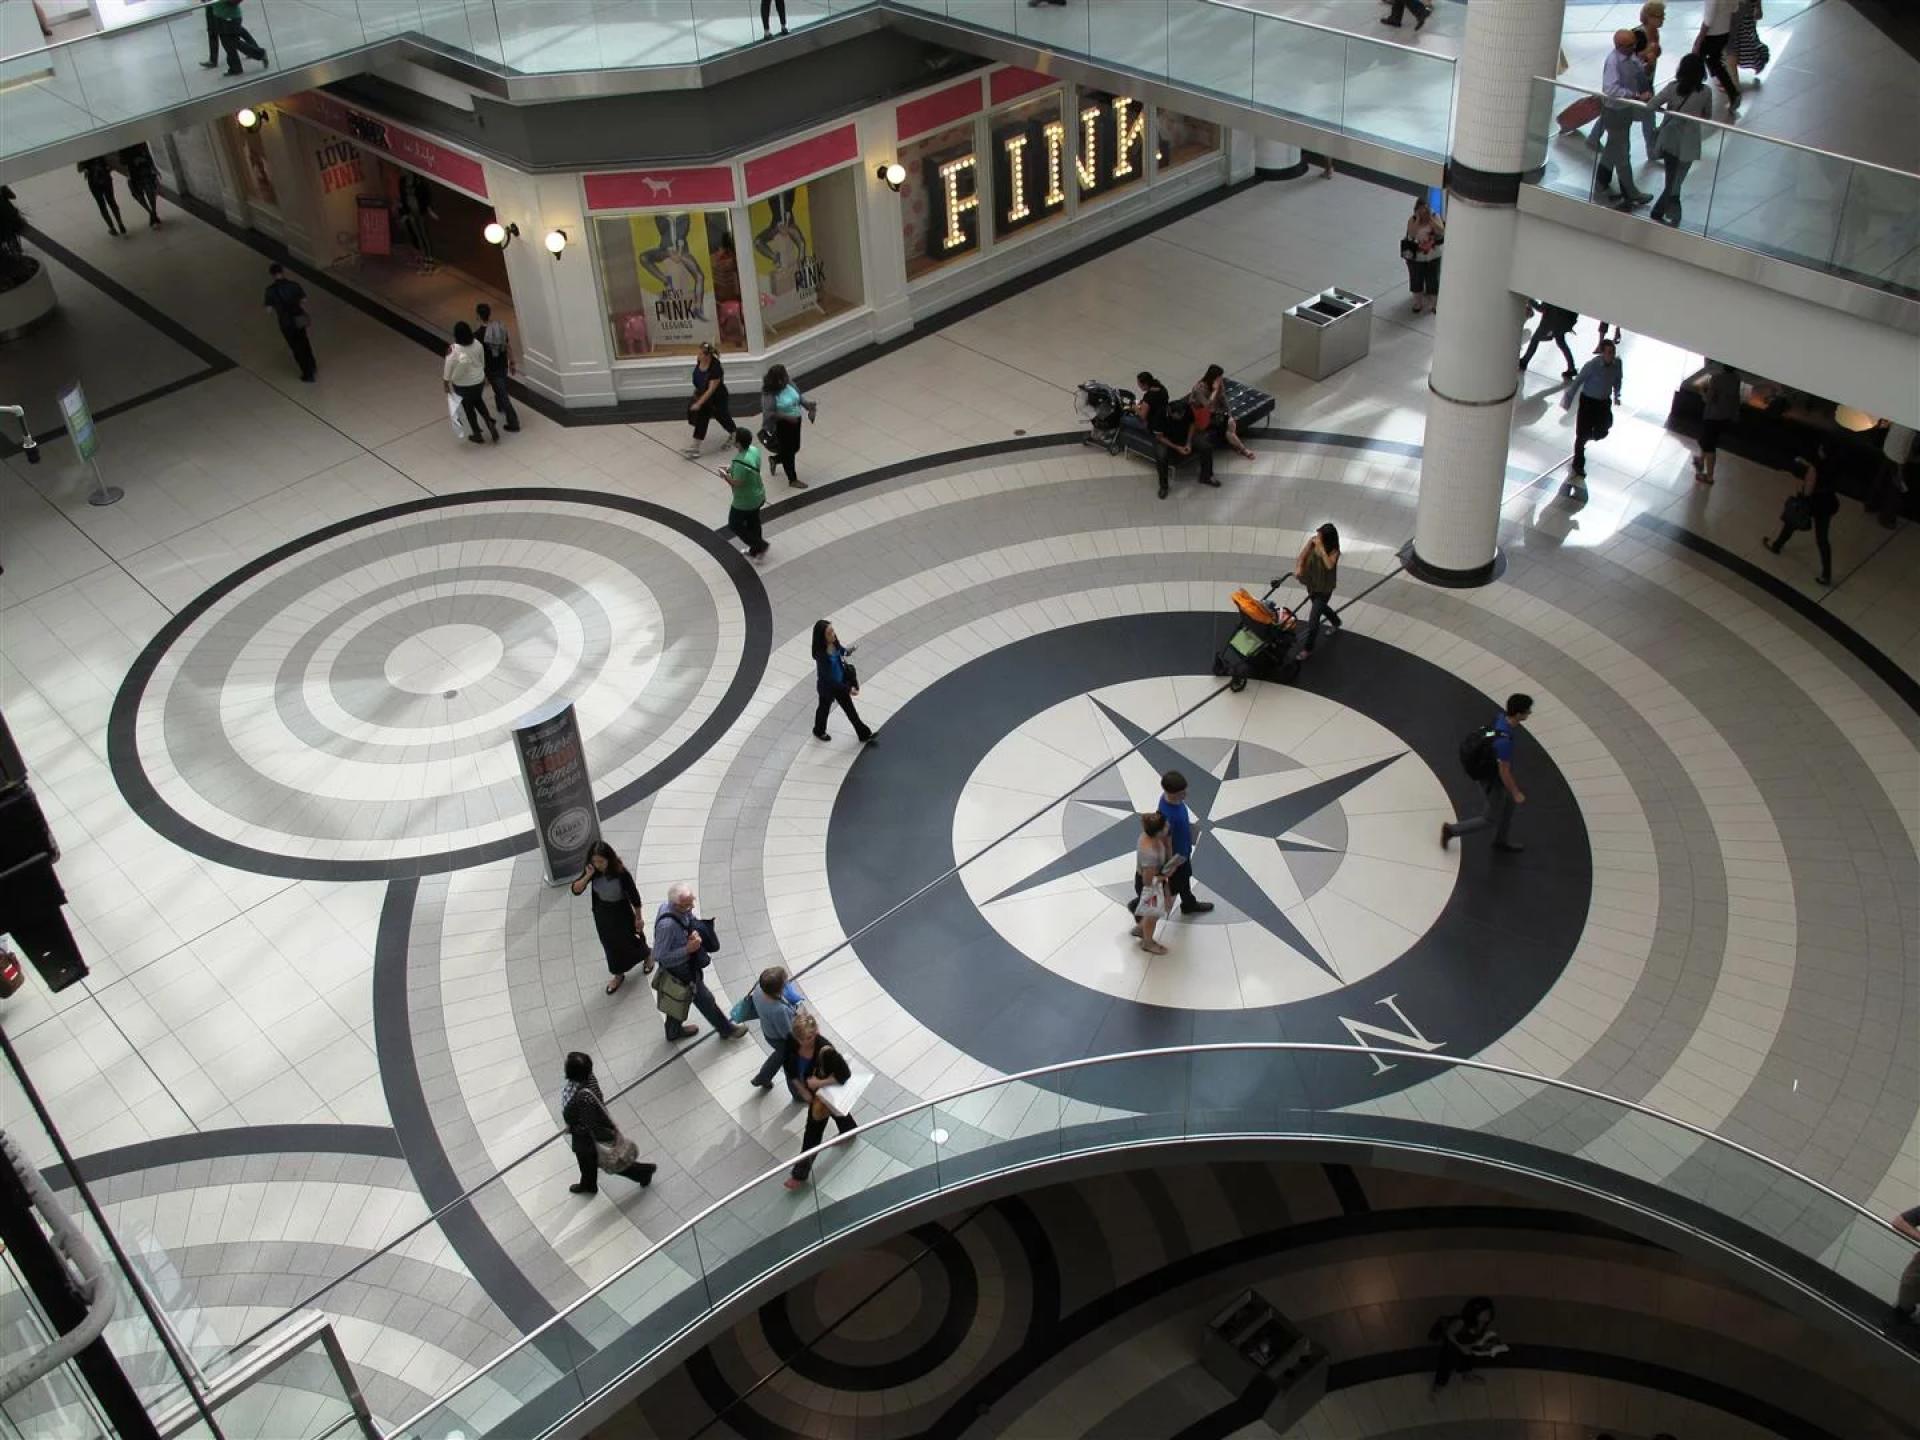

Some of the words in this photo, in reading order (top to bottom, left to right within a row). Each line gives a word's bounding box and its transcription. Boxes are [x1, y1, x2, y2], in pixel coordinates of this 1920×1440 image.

[316, 141, 361, 171] LOVE
[940, 96, 1162, 249] PINK
[320, 159, 364, 193] PINK
[655, 299, 696, 321] PINK
[1337, 993, 1447, 1076] N
